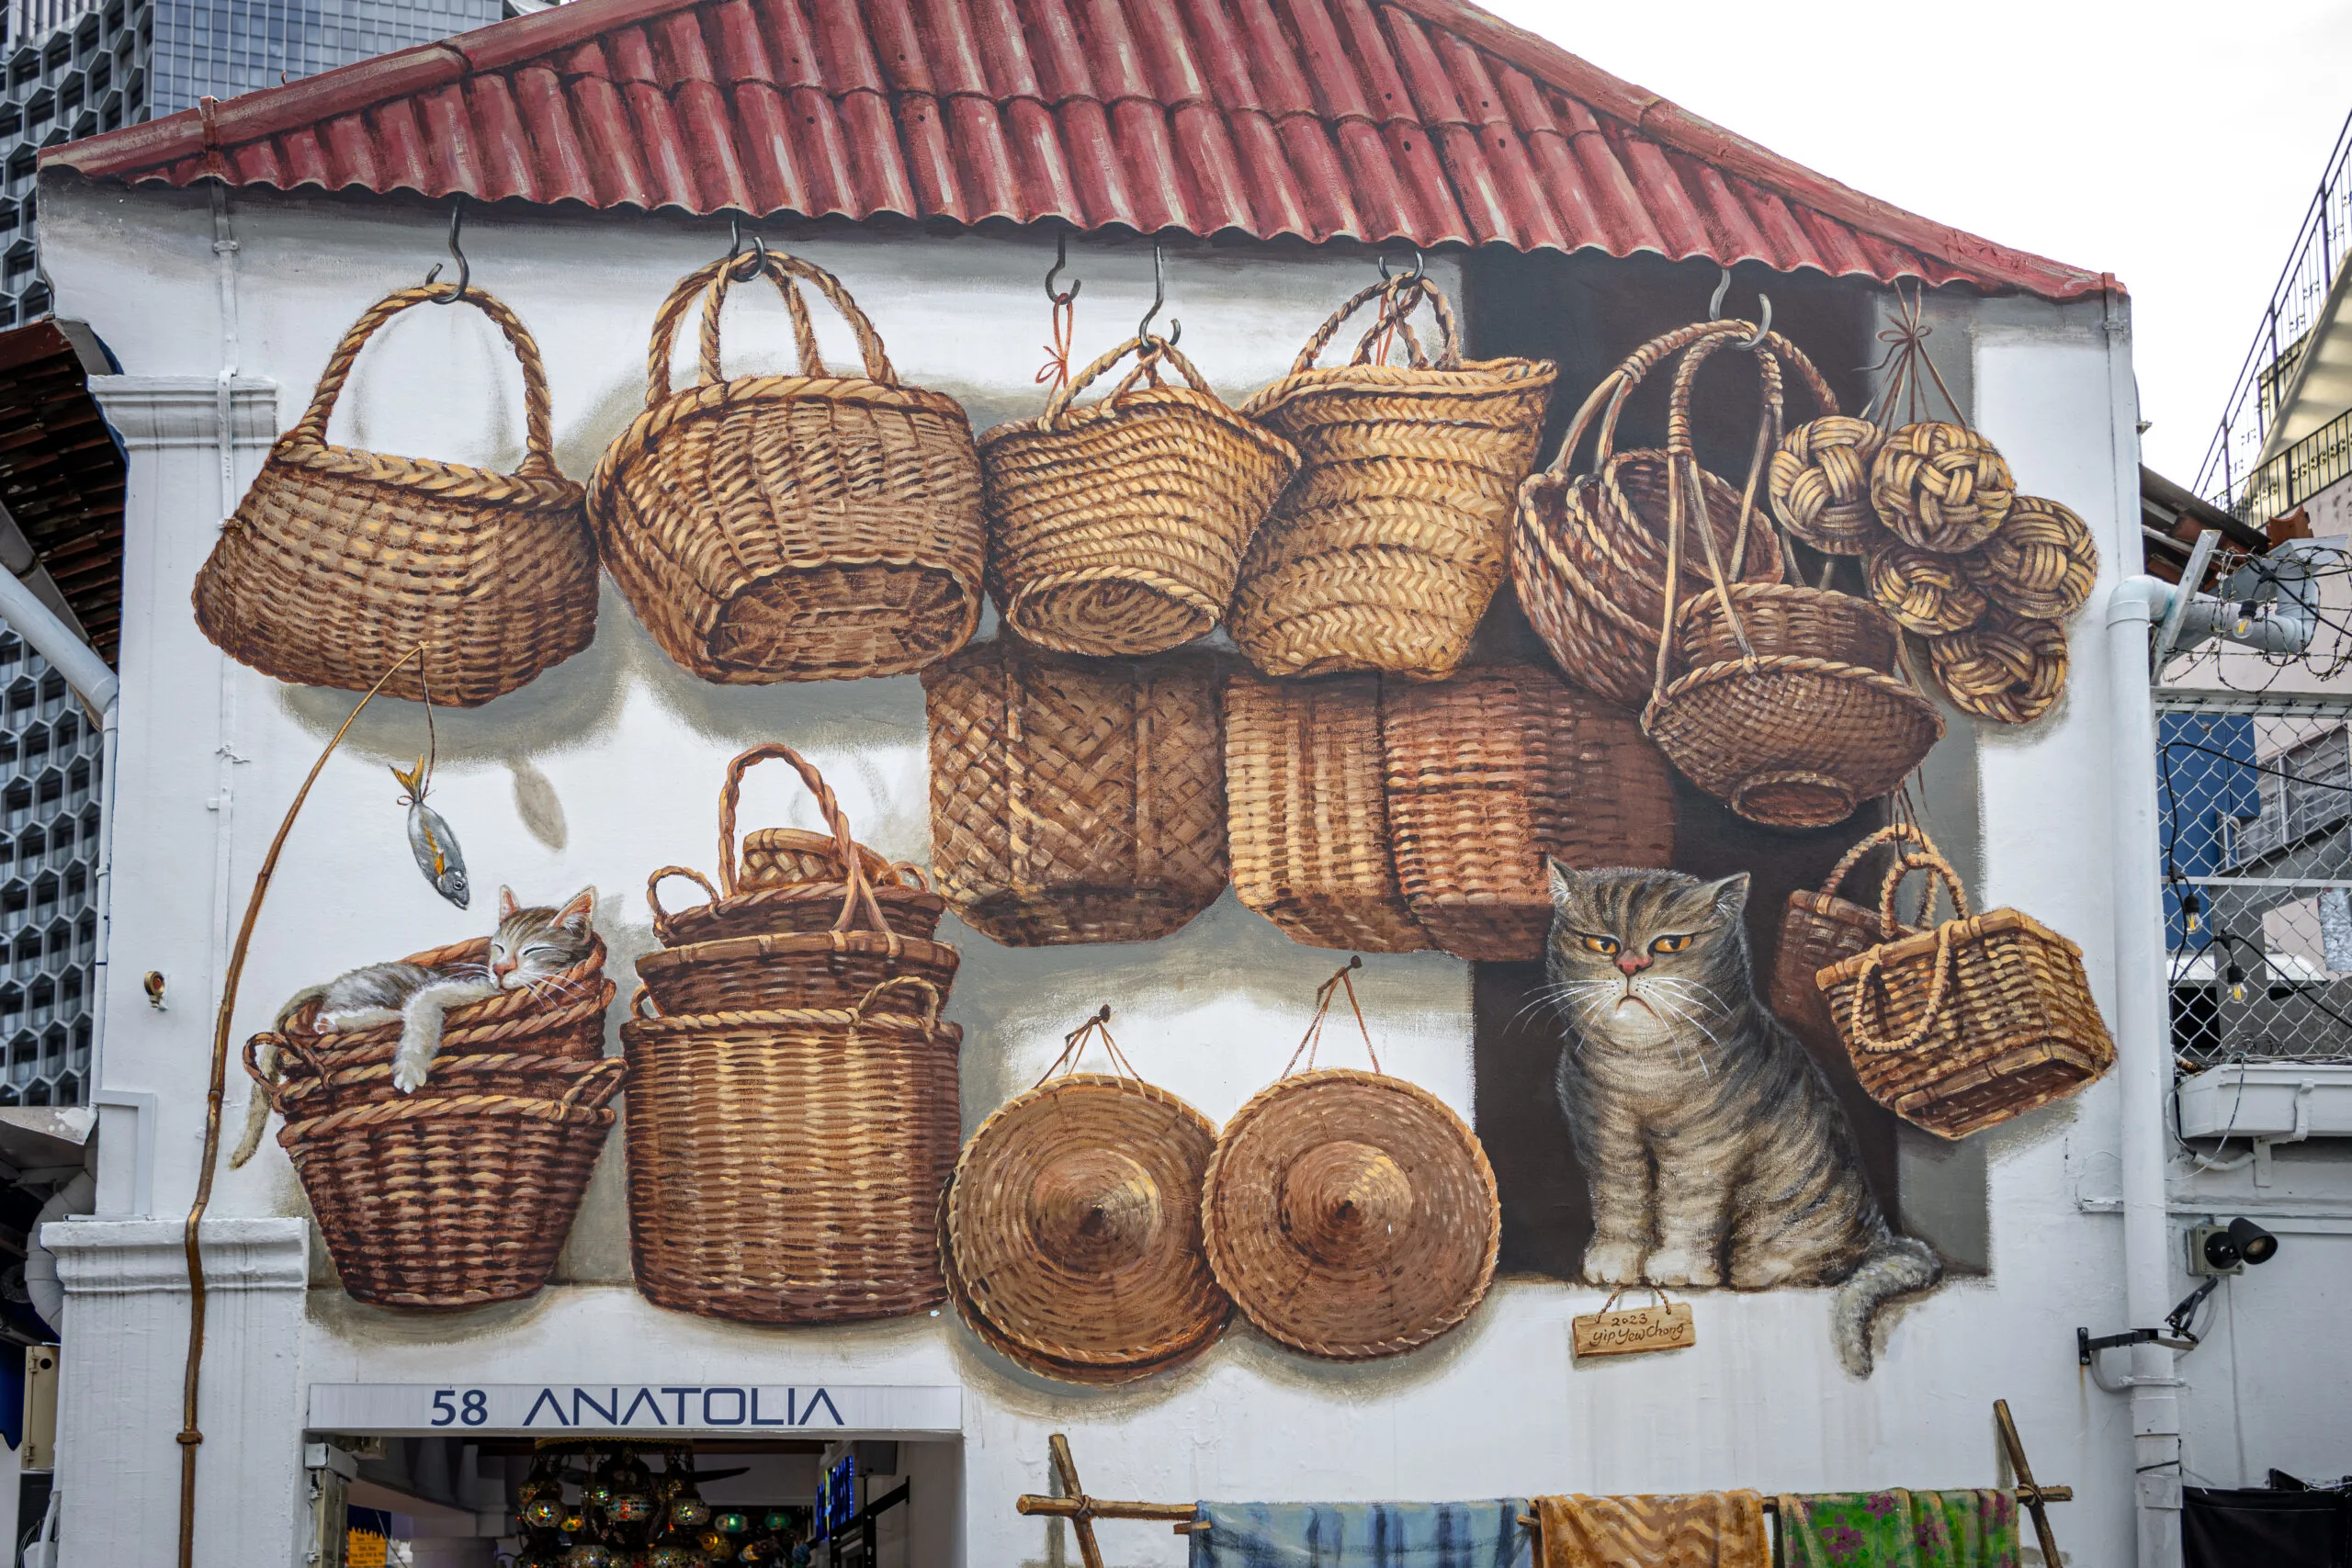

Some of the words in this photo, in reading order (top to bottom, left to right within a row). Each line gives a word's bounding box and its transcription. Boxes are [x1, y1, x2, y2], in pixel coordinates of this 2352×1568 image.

[1611, 1313, 1647, 1326] 2023
[1615, 1328, 1645, 1346] Yew
[1645, 1320, 1684, 1340] Chong
[431, 1389, 488, 1426] 58
[522, 1387, 844, 1425] ANATOLIA
